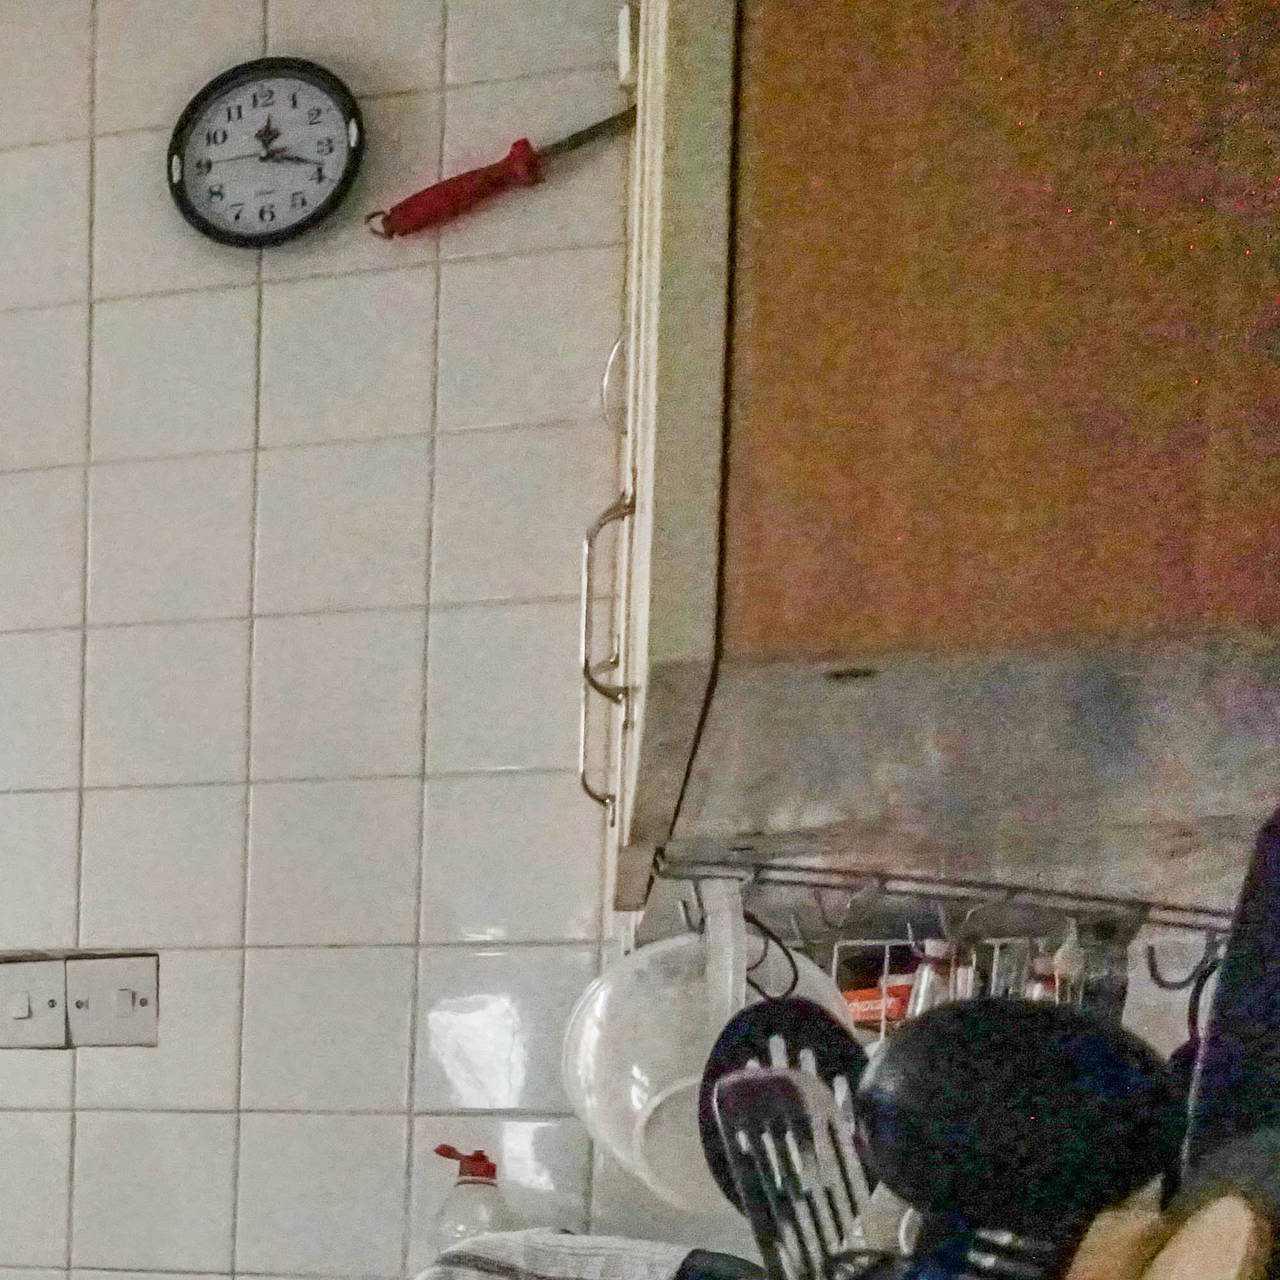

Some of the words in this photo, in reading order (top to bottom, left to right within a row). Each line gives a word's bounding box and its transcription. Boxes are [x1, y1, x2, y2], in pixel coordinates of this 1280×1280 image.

[251, 88, 275, 109] 12
[289, 91, 299, 110] 1
[225, 104, 243, 122] 11
[307, 108, 322, 126] 2
[204, 128, 228, 147] 10
[316, 138, 334, 156] 3
[195, 157, 213, 177] 9
[309, 165, 326, 185] 4
[208, 183, 224, 203] 8
[290, 190, 308, 211] 5
[230, 202, 245, 222] 7
[258, 203, 277, 223] 6
